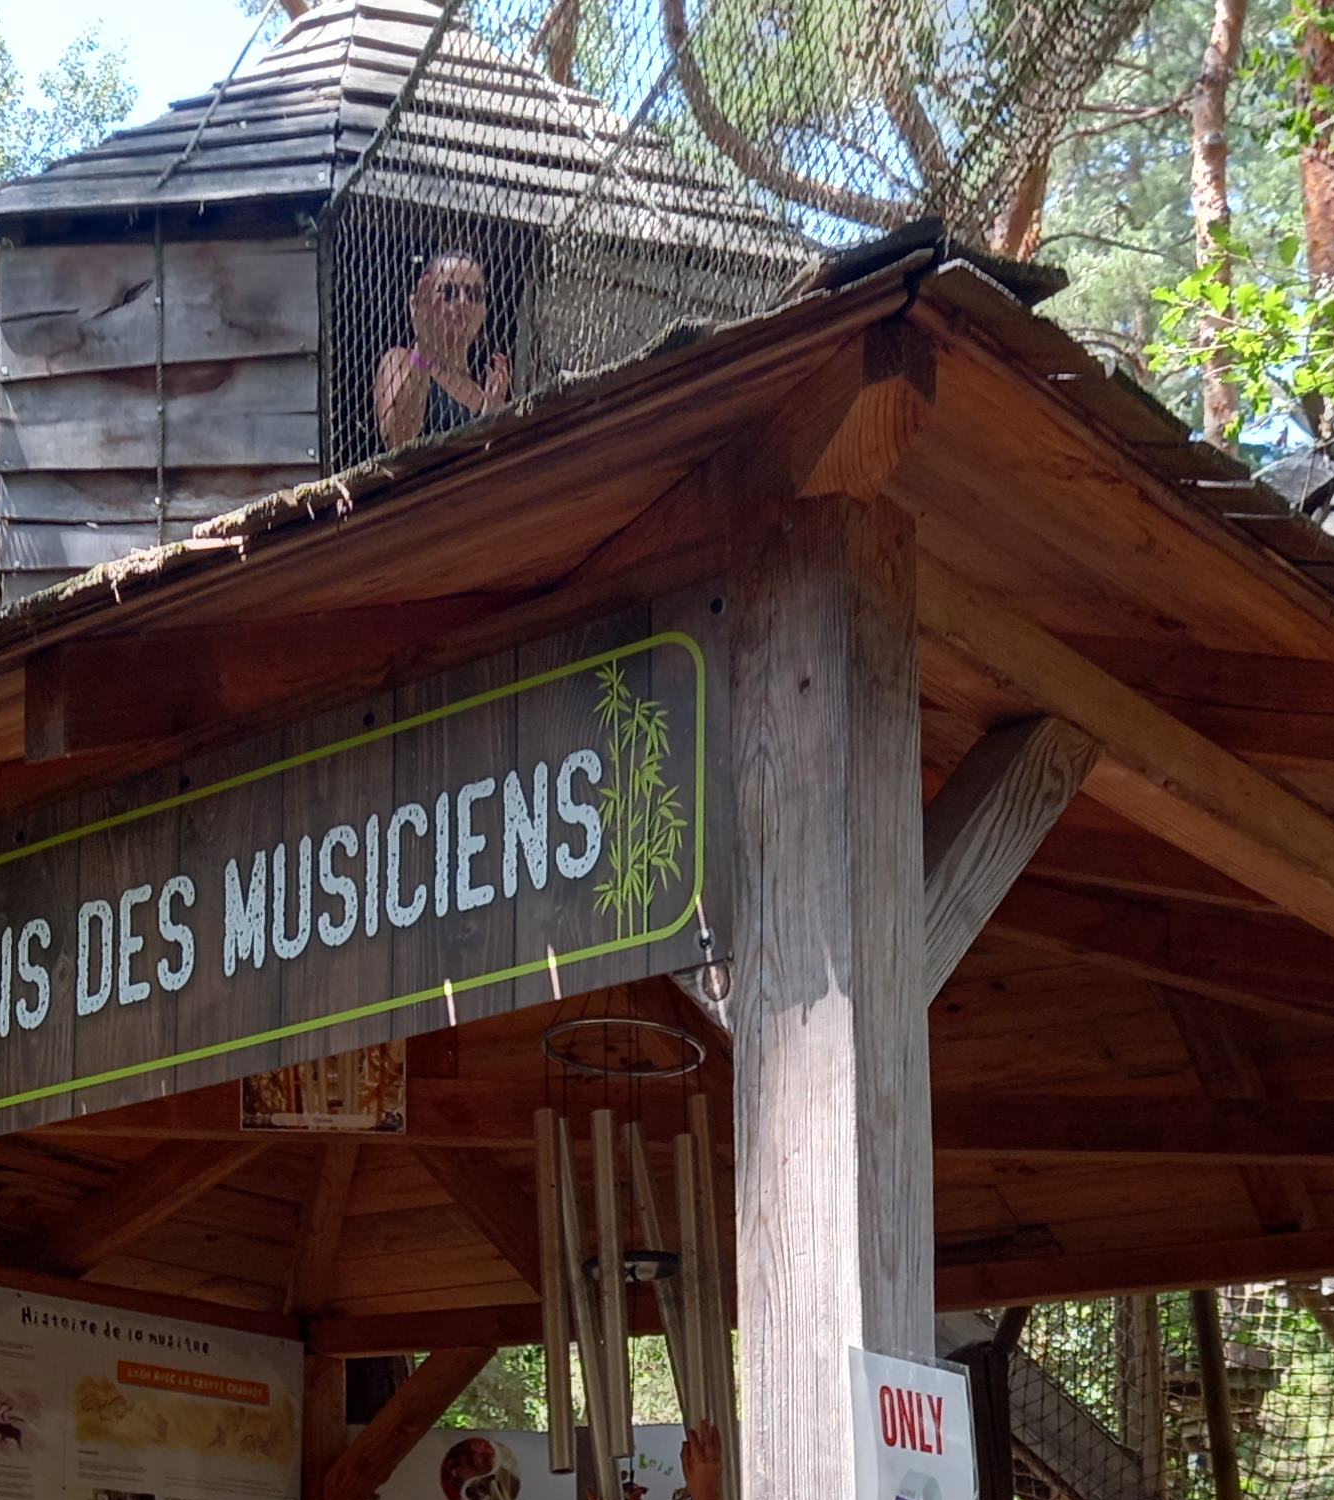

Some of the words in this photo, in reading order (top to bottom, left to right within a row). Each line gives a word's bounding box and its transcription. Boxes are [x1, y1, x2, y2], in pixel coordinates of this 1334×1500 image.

[76, 874, 197, 1017] DES
[223, 748, 605, 978] MUSICIENS
[21, 1306, 97, 1335] Histoire
[103, 1320, 121, 1340] de
[127, 1327, 144, 1342] la
[148, 1331, 210, 1355] musique
[878, 1385, 944, 1455] ONLY
